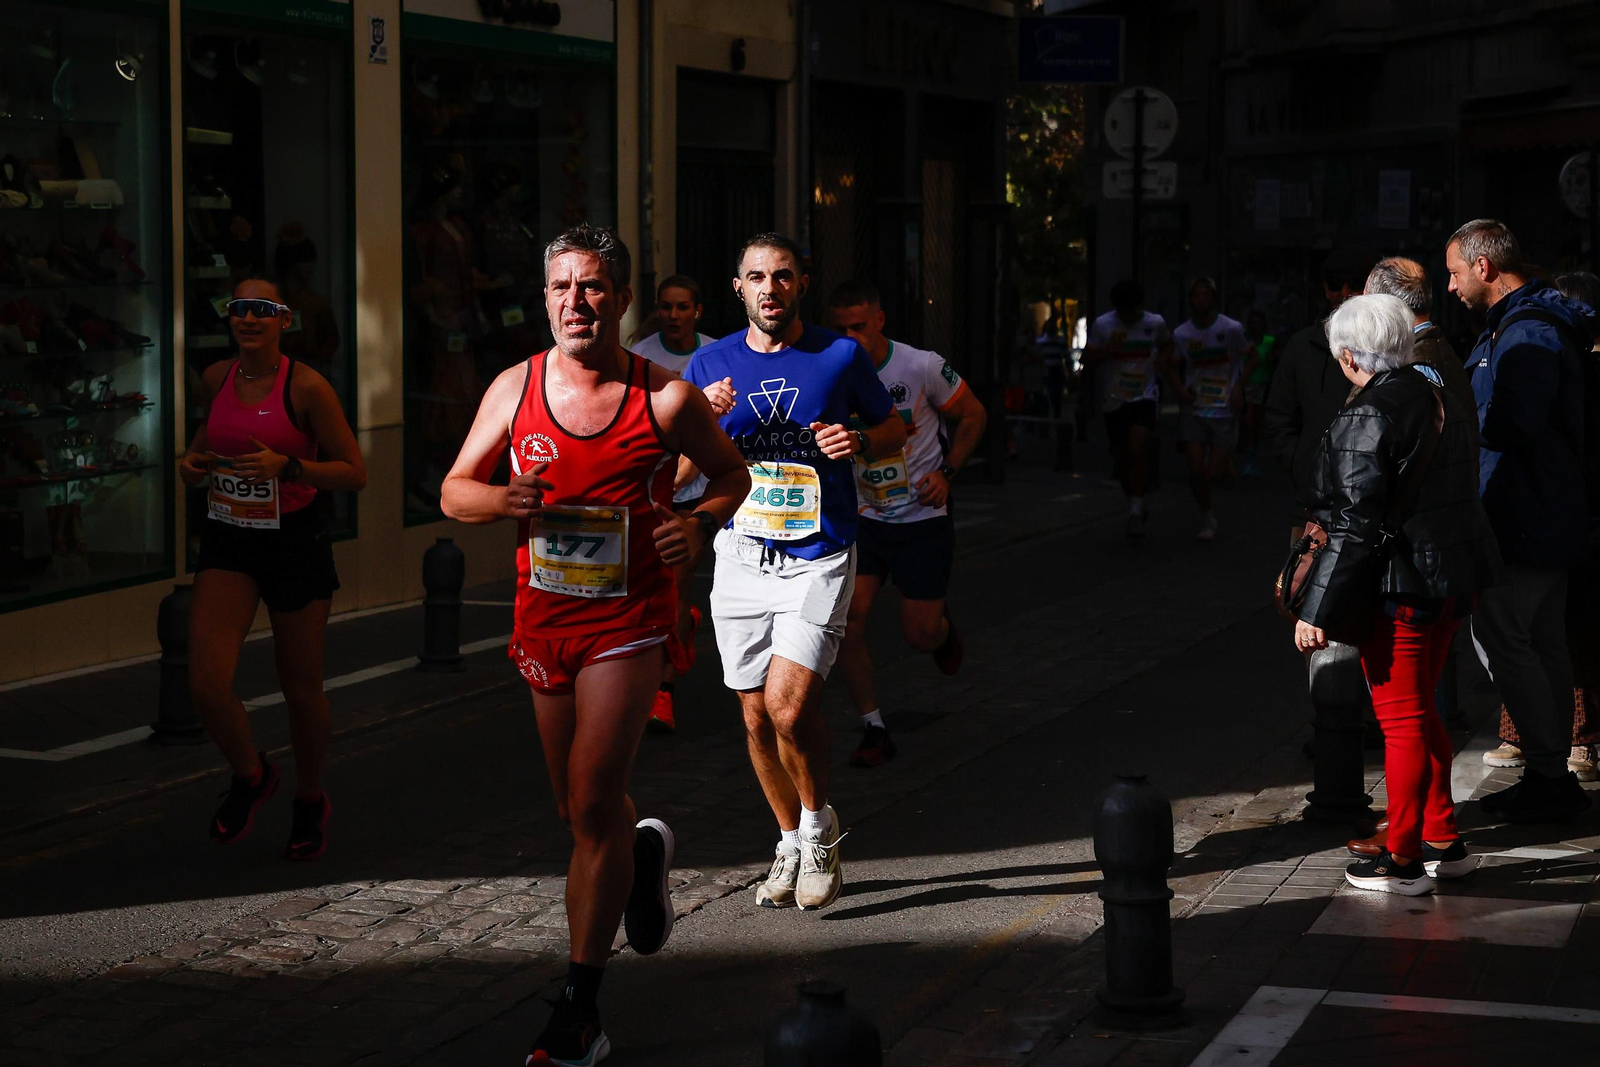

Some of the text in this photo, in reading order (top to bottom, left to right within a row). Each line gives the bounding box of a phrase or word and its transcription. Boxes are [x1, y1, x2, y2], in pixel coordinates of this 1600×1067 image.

[731, 37, 746, 70] 6
[533, 433, 559, 459] ATLETISMO
[213, 475, 271, 498] 1095
[750, 486, 805, 507] 465
[546, 533, 606, 558] 177
